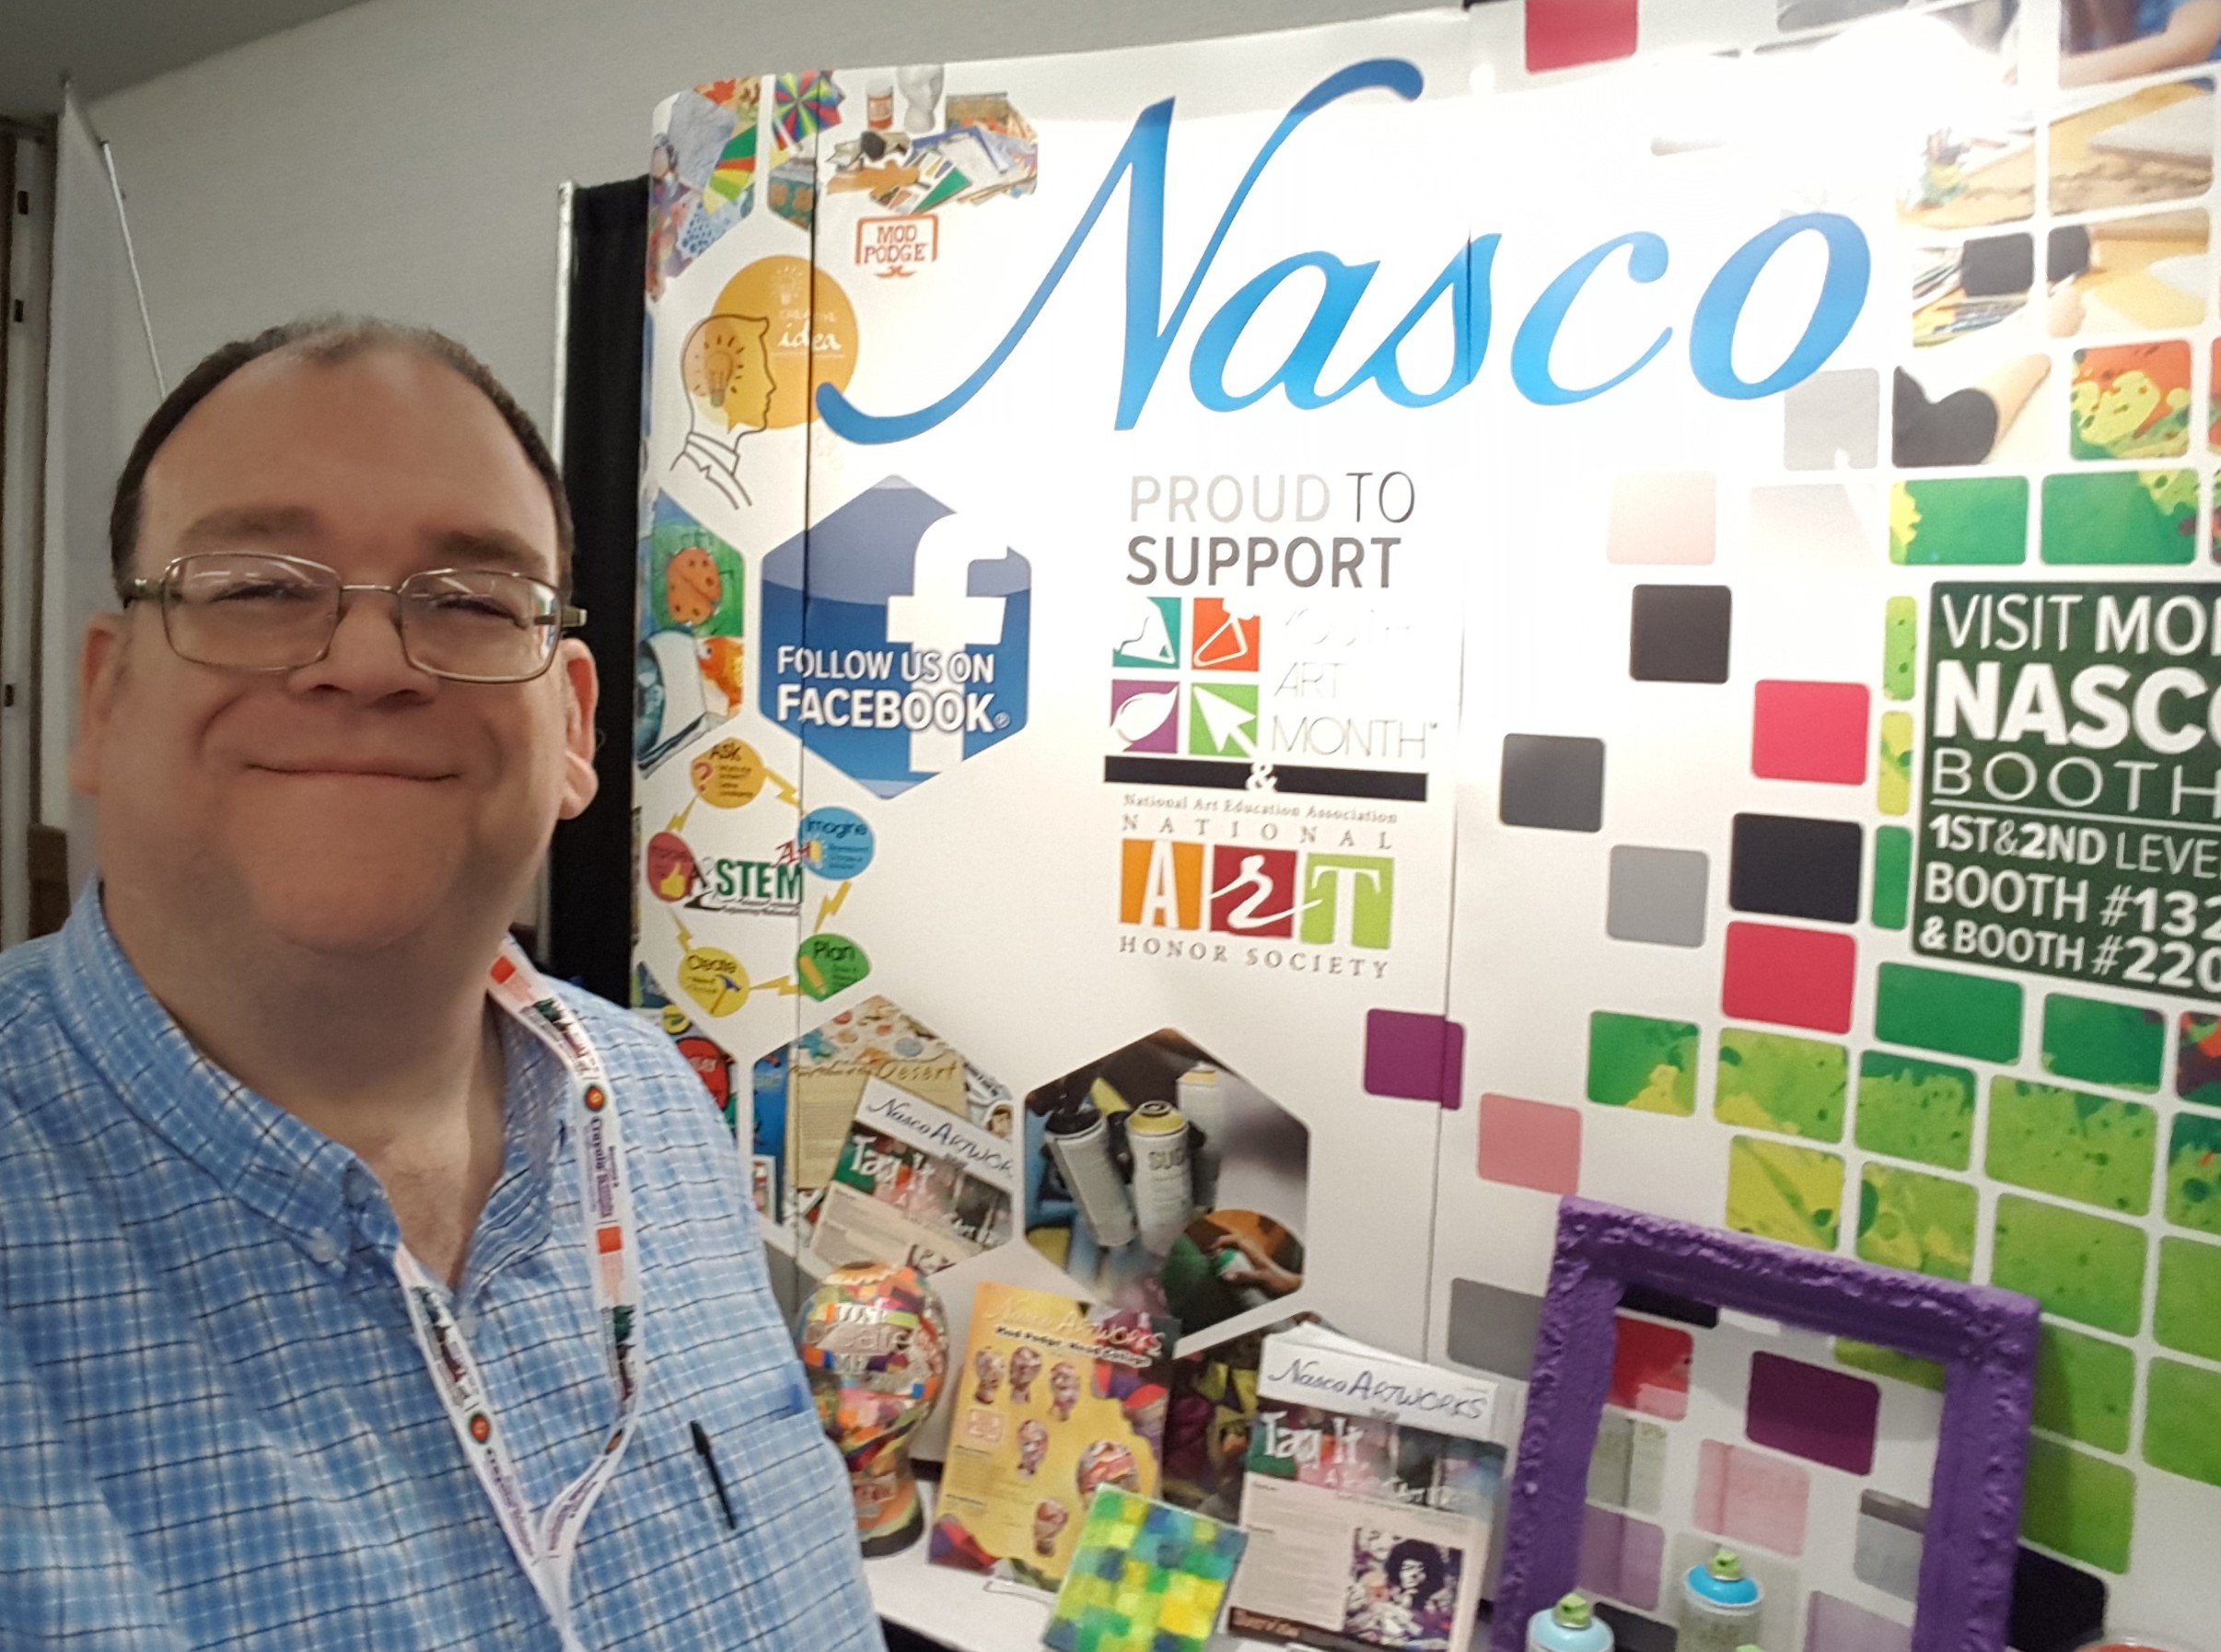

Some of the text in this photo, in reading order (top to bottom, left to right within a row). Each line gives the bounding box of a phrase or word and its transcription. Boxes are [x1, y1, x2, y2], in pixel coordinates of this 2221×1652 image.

[816, 59, 1872, 445] Nasco
[864, 242, 928, 264] PODGE
[877, 224, 917, 244] MOD
[1130, 471, 1415, 524] PROUD TO
[1126, 534, 1401, 588] SUPPORT
[1940, 593, 2221, 657] VISIT MO
[776, 646, 994, 683] FOLLOW US ON
[1933, 658, 2221, 754] NASC
[1271, 714, 1426, 759] MONTH
[1245, 761, 1278, 793] &
[1932, 747, 2221, 821] BOOTH
[1122, 793, 1398, 824] National Art Education Association
[1926, 811, 2221, 879] 1ST&2ND LEVE
[715, 858, 802, 900] STEM
[1923, 860, 2089, 924] BOOTH
[1118, 935, 1390, 980] HONOR SOCIETY
[1918, 915, 1948, 951] &
[1952, 919, 2086, 972] BOOTH
[867, 1098, 933, 1135] Nasco
[1267, 1357, 1348, 1394] Nasco
[1260, 1411, 1323, 1471] Tag
